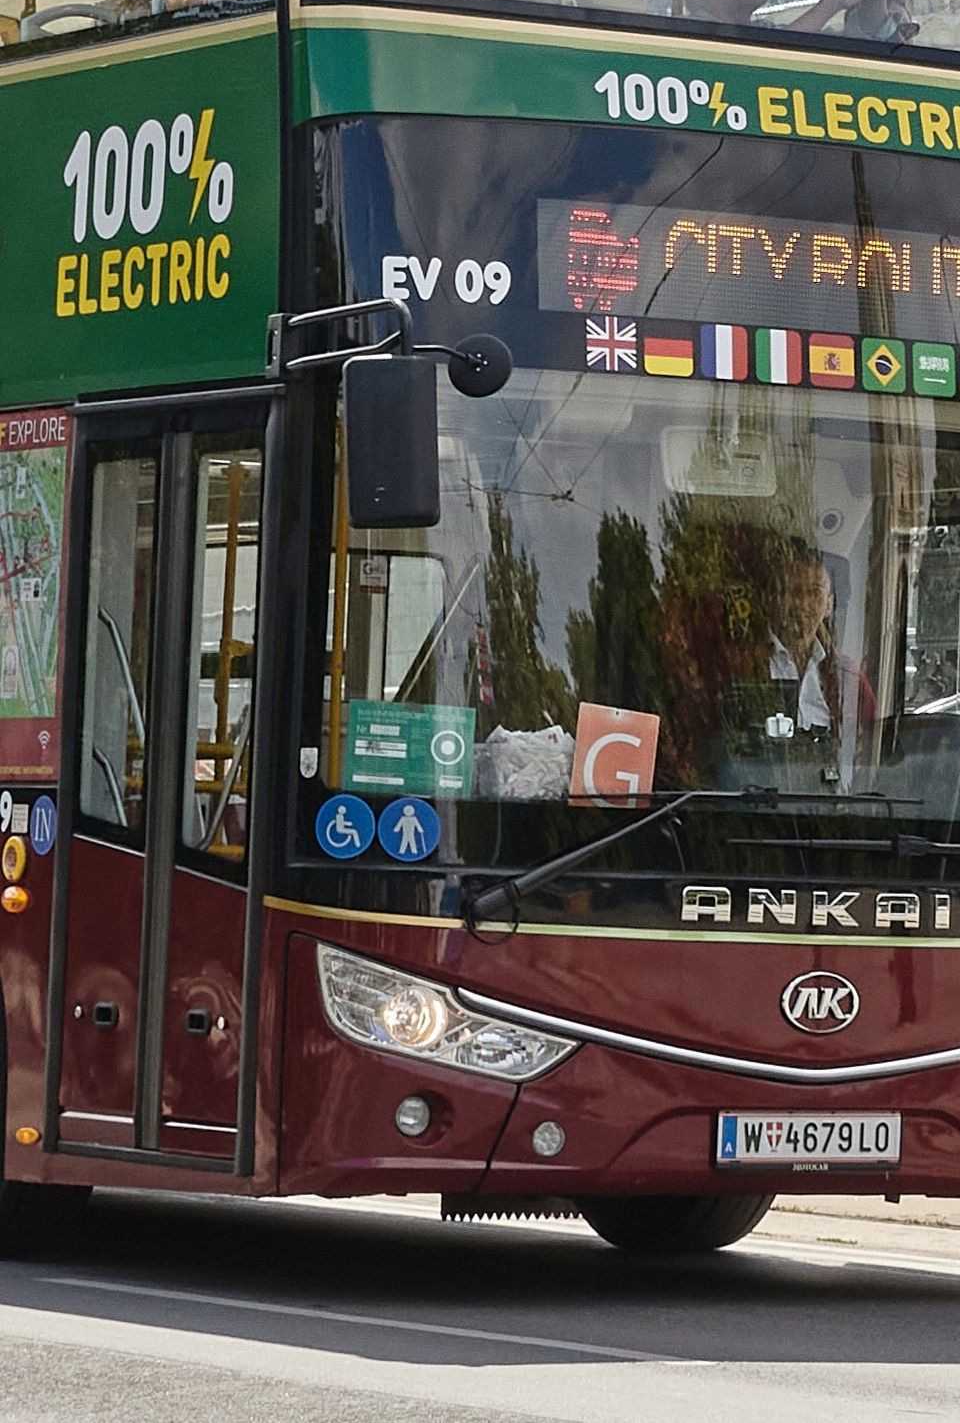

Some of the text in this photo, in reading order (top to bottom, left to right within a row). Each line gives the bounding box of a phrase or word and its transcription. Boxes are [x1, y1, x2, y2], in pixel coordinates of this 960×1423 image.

[594, 70, 747, 130] 100%
[63, 108, 234, 243] 100%
[55, 233, 231, 318] ELECTRIC
[665, 219, 801, 280] CITY
[382, 255, 511, 305] EV 09
[8, 416, 67, 445] EXPLORE
[582, 732, 642, 808] G
[680, 885, 951, 930] ANKAI
[724, 1141, 733, 1153] A
[744, 1121, 763, 1154] W
